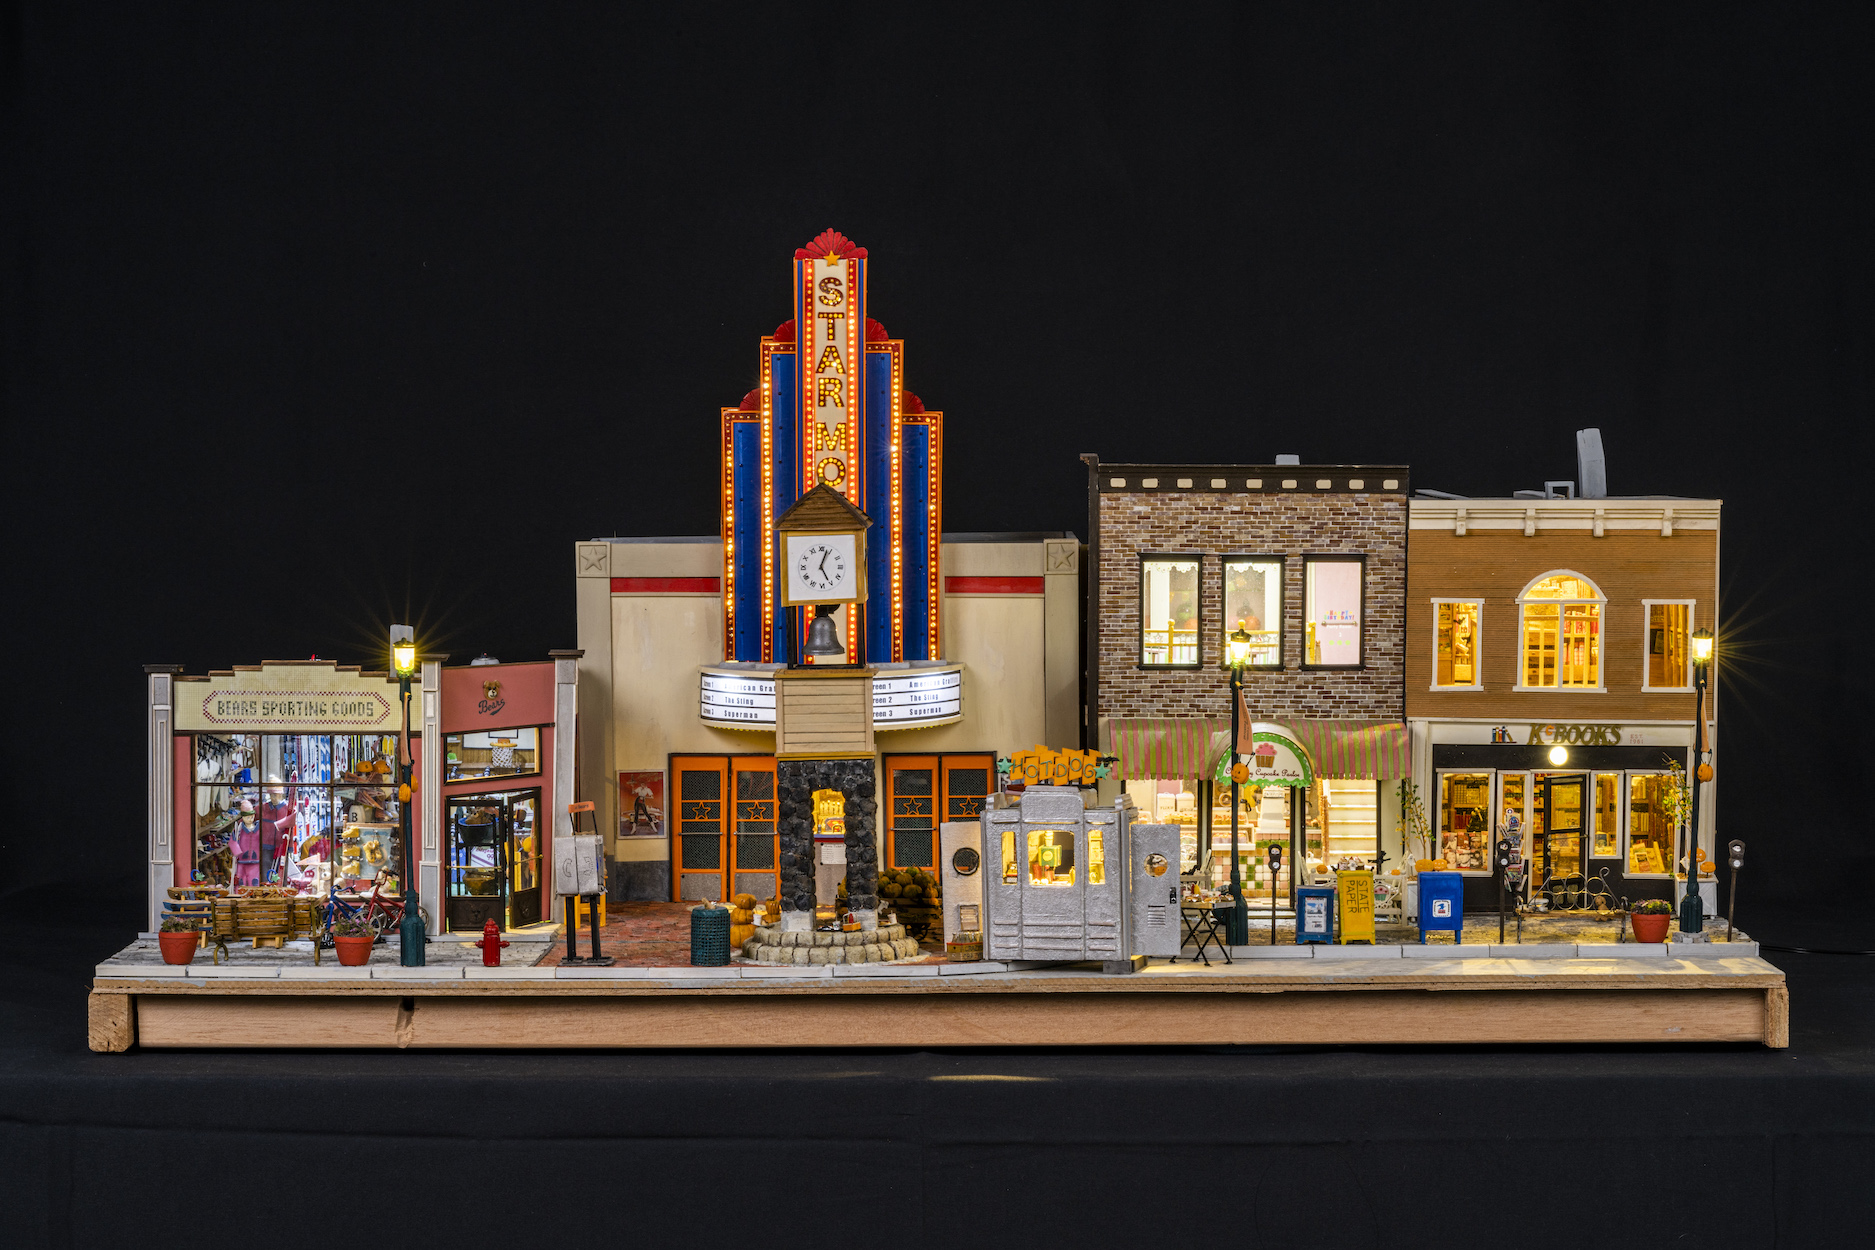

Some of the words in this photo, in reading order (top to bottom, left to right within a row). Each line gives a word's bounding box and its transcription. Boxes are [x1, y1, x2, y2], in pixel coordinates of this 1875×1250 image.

[724, 682, 756, 691] Arican
[725, 696, 734, 704] The
[736, 697, 754, 706] Sting
[910, 694, 922, 702] The
[923, 693, 939, 701] Sting
[217, 700, 257, 716] BEARS
[262, 700, 327, 717] SPORTING
[332, 701, 374, 717] GOODS
[478, 698, 505, 716] Bears
[909, 706, 942, 716] Superman
[724, 709, 758, 719] Superman
[888, 709, 893, 717] 3
[1255, 767, 1279, 779] Cupcake
[1345, 880, 1358, 914] PAPER
[1358, 880, 1370, 913] STATE
